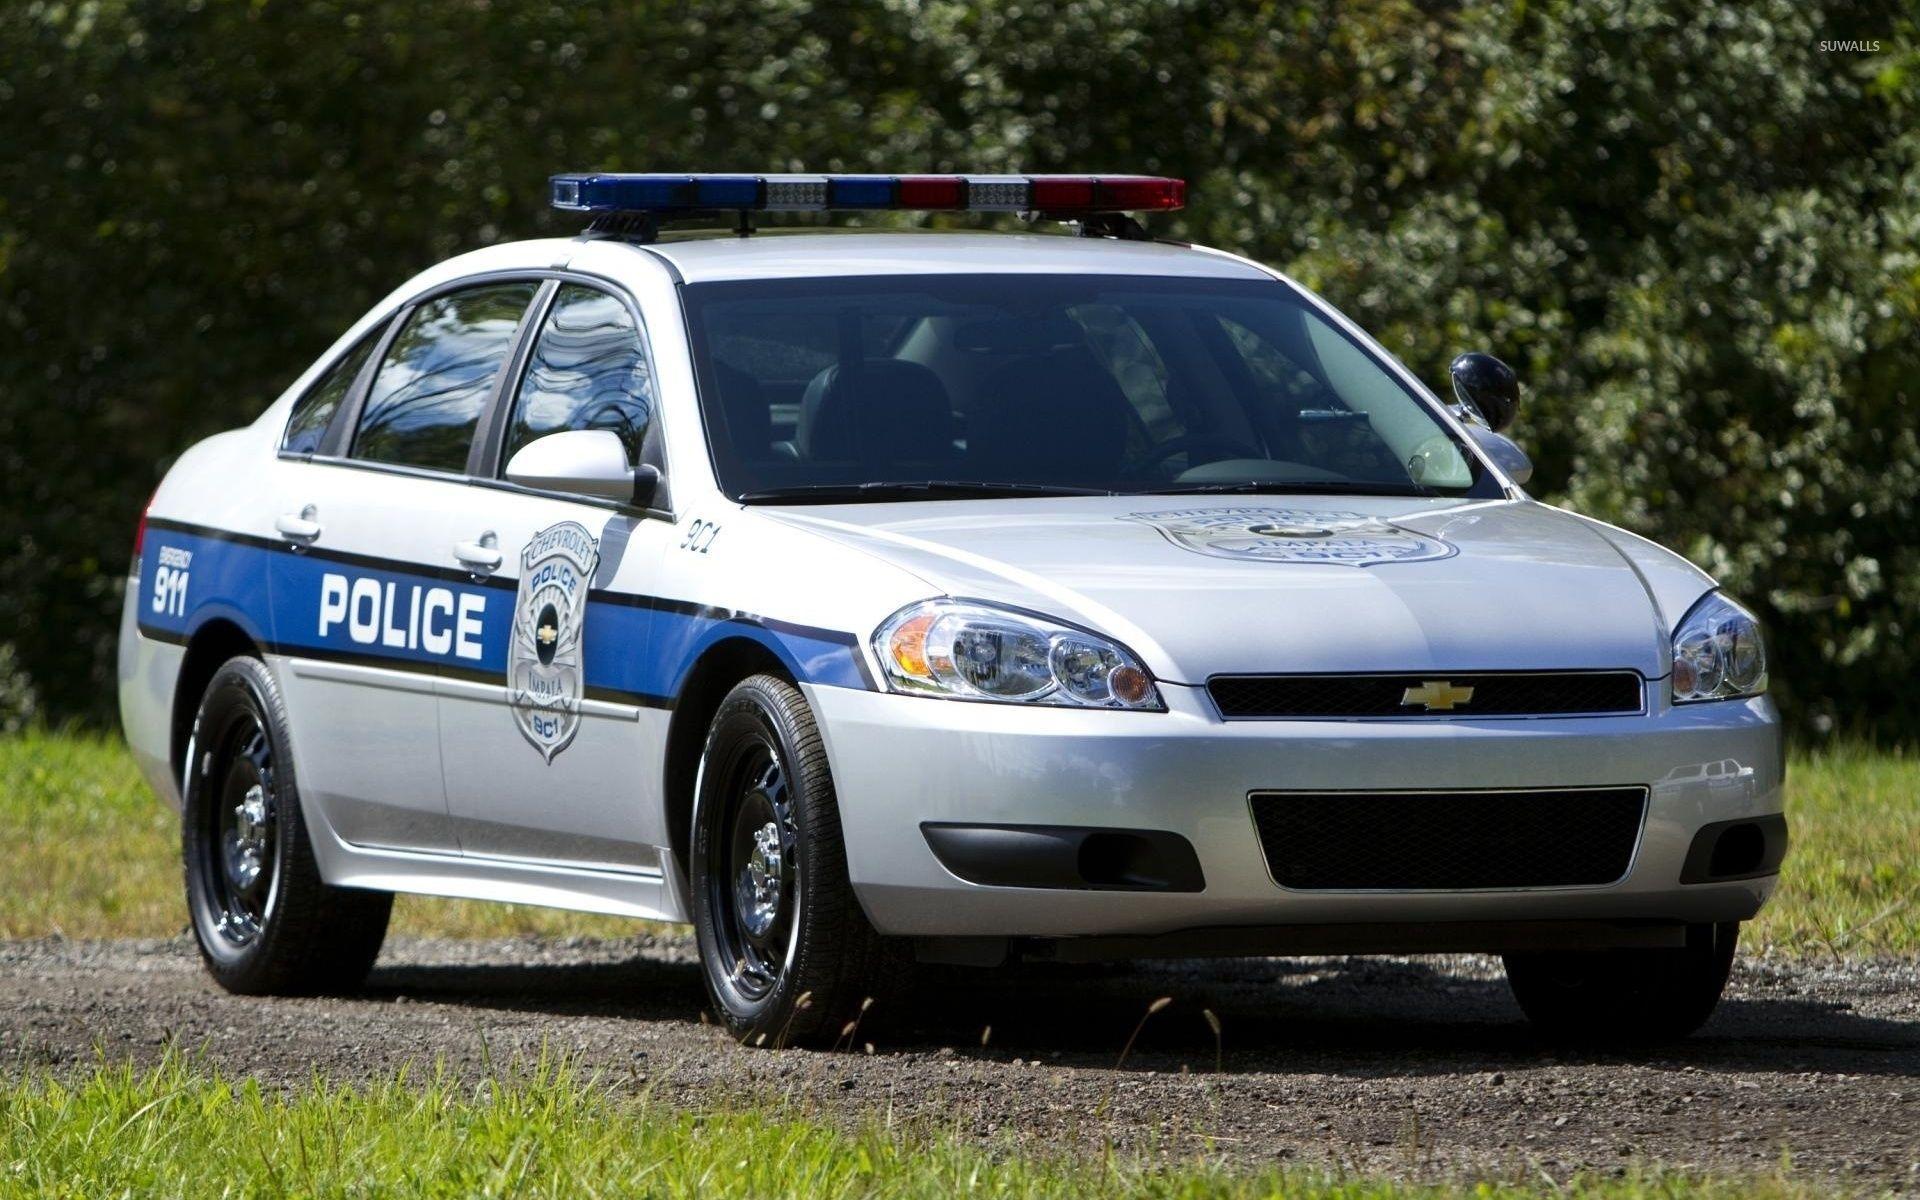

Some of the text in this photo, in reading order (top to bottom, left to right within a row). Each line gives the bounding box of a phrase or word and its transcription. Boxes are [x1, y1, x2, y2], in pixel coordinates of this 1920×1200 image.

[531, 529, 591, 565] CHEVROLET
[680, 519, 722, 554] 9C1
[152, 566, 190, 618] 911
[531, 564, 577, 597] POLICE
[318, 573, 486, 660] POLICE
[528, 671, 563, 697] IMPALA
[533, 715, 559, 739] 9C1
